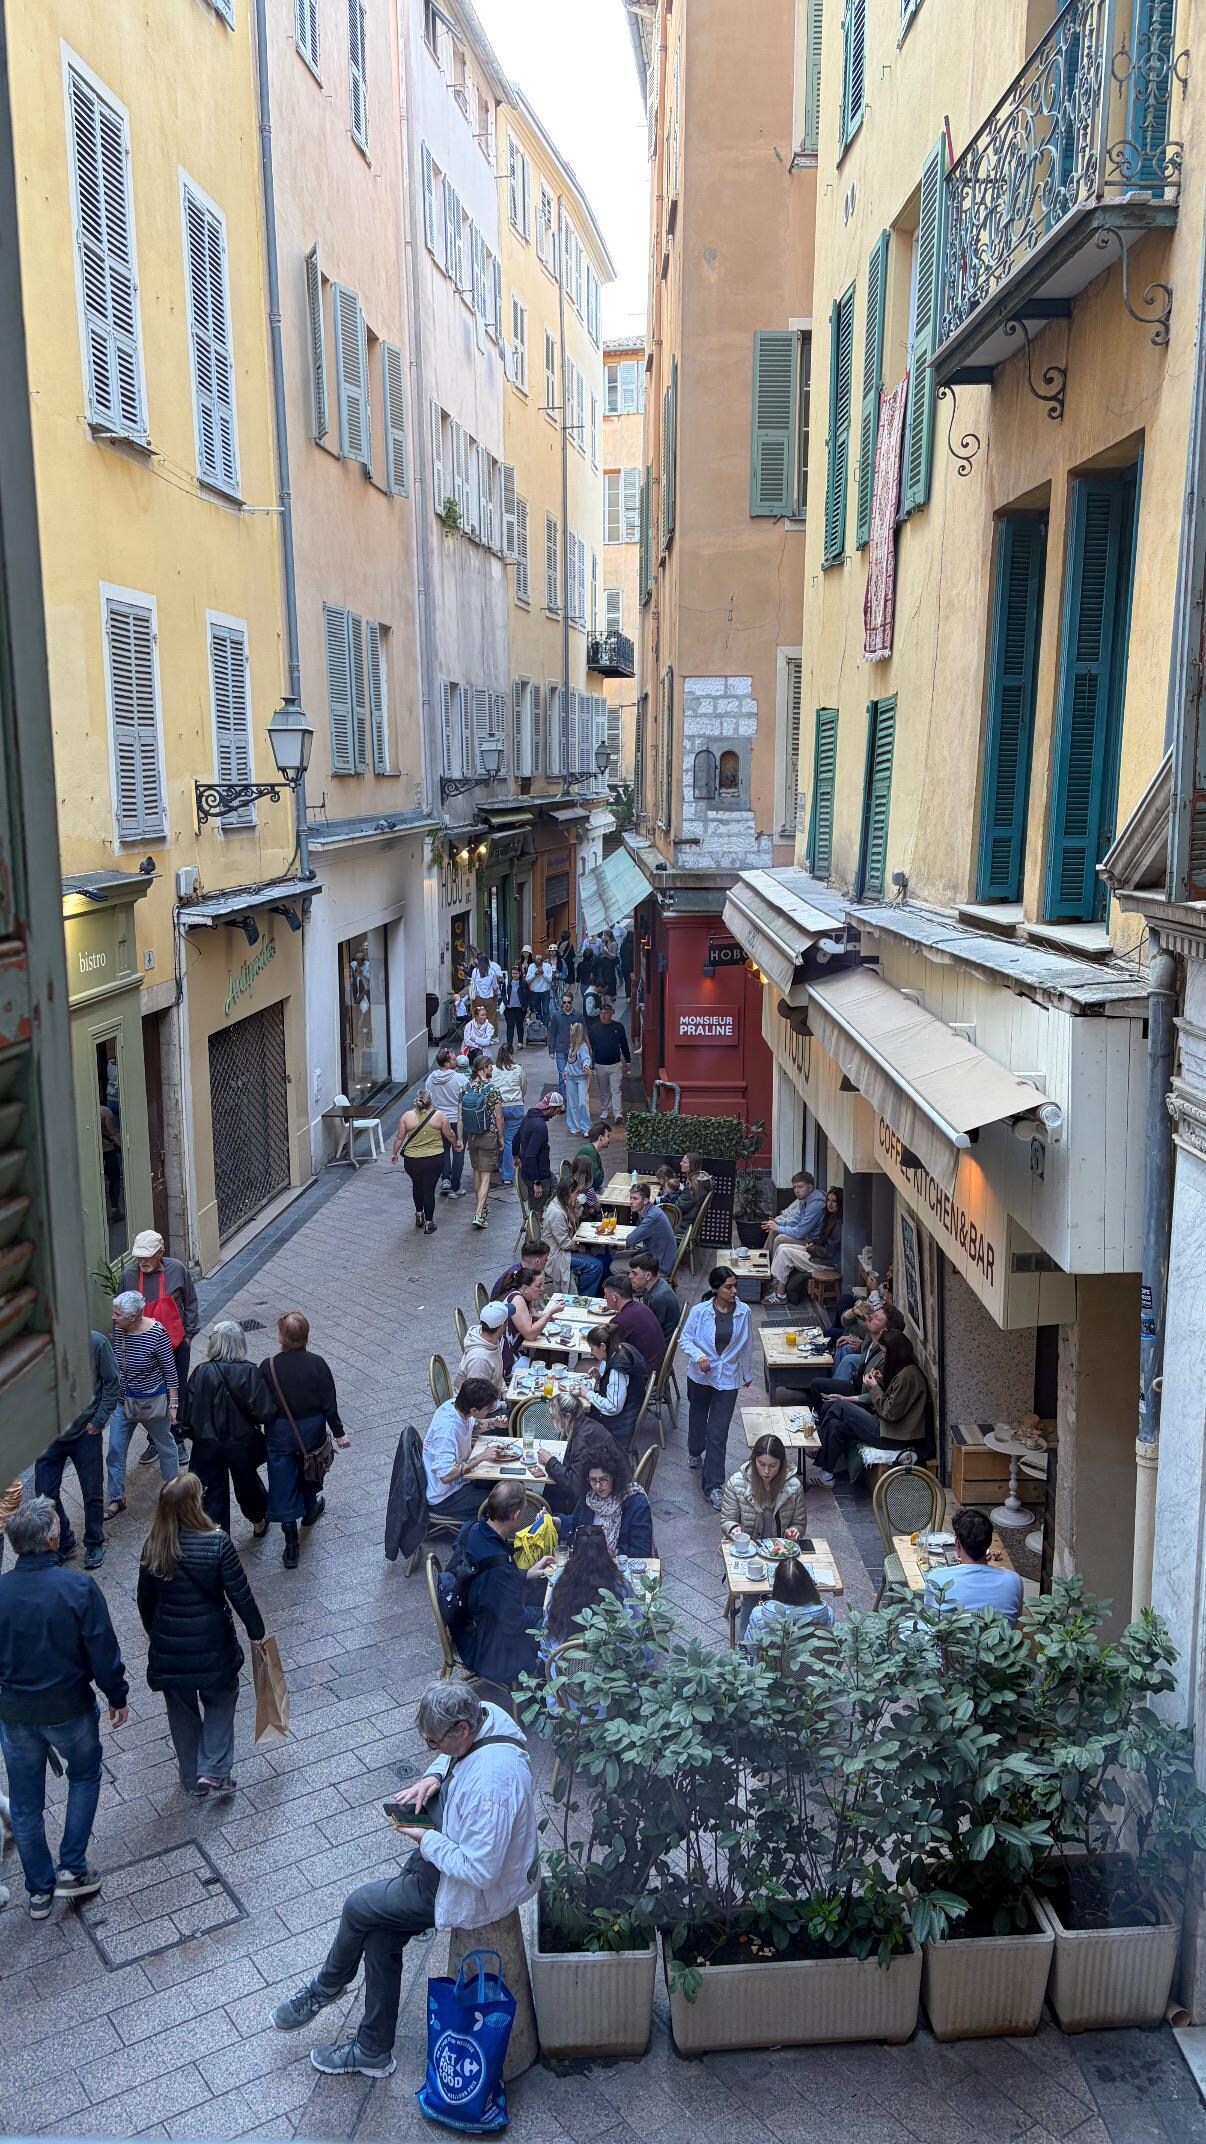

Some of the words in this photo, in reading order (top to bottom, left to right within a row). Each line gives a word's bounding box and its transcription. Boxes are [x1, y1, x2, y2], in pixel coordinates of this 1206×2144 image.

[79, 952, 106, 973] bistro
[679, 1016, 733, 1025] MONSIEUR
[679, 1025, 733, 1036] PRALINE
[879, 1117, 911, 1184] COFF
[442, 2046, 457, 2066] AT
